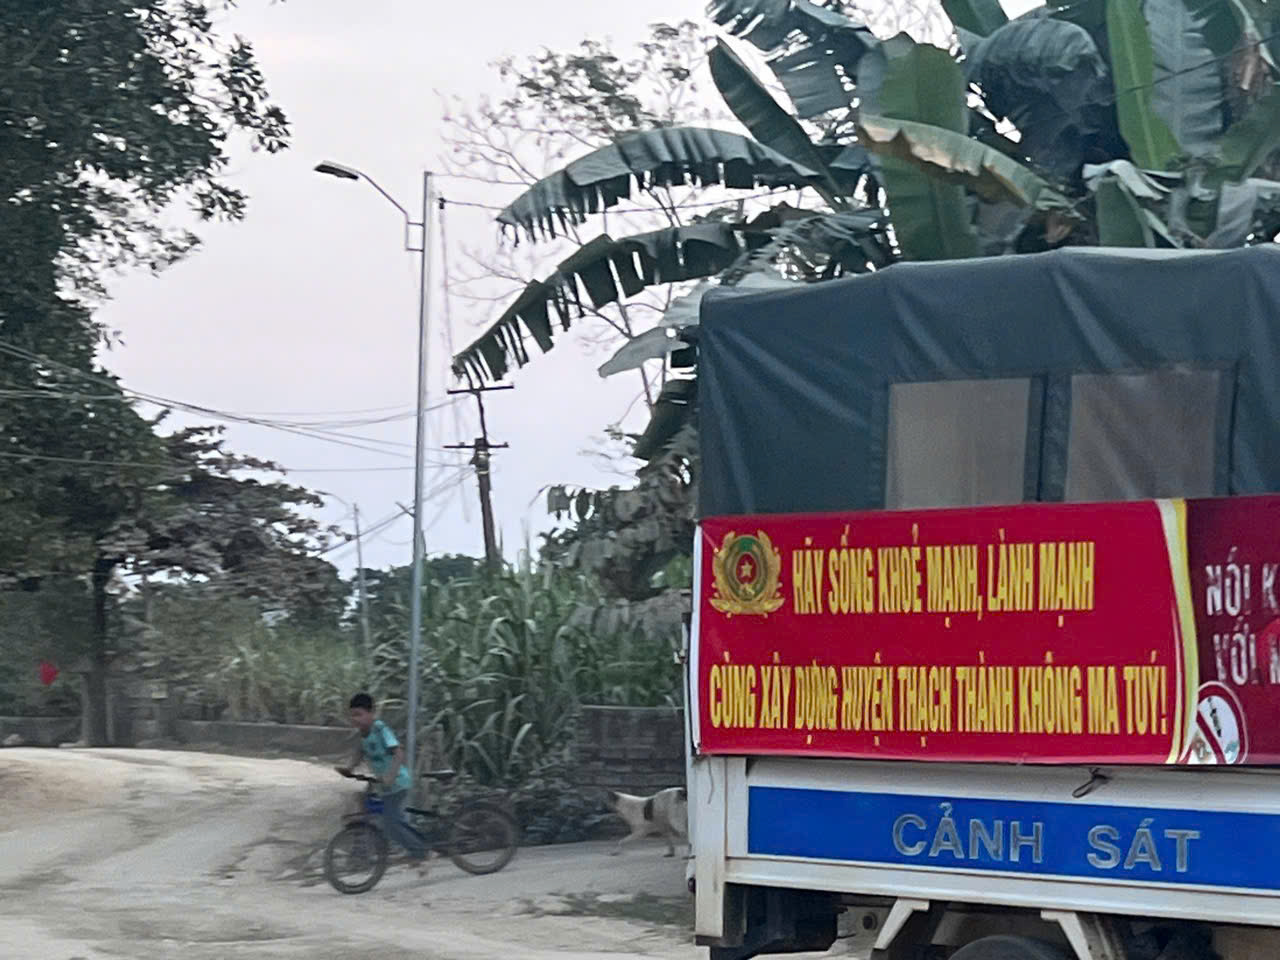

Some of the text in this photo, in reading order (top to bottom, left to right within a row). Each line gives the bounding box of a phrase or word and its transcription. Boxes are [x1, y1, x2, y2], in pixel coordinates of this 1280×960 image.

[828, 524, 874, 615] SỐNG
[926, 545, 983, 628] MẠNH,
[987, 528, 1034, 612] LÀNH
[1039, 541, 1095, 628] MẠNH
[1205, 546, 1250, 617] NÓI
[1213, 615, 1258, 686] VỚI
[710, 650, 1168, 748] CÙNG XÂY DỰNG HUYỆN THẠCH THÀNH KHÔNG MA TUÝ!
[892, 802, 1201, 873] CẢNH SÁT
